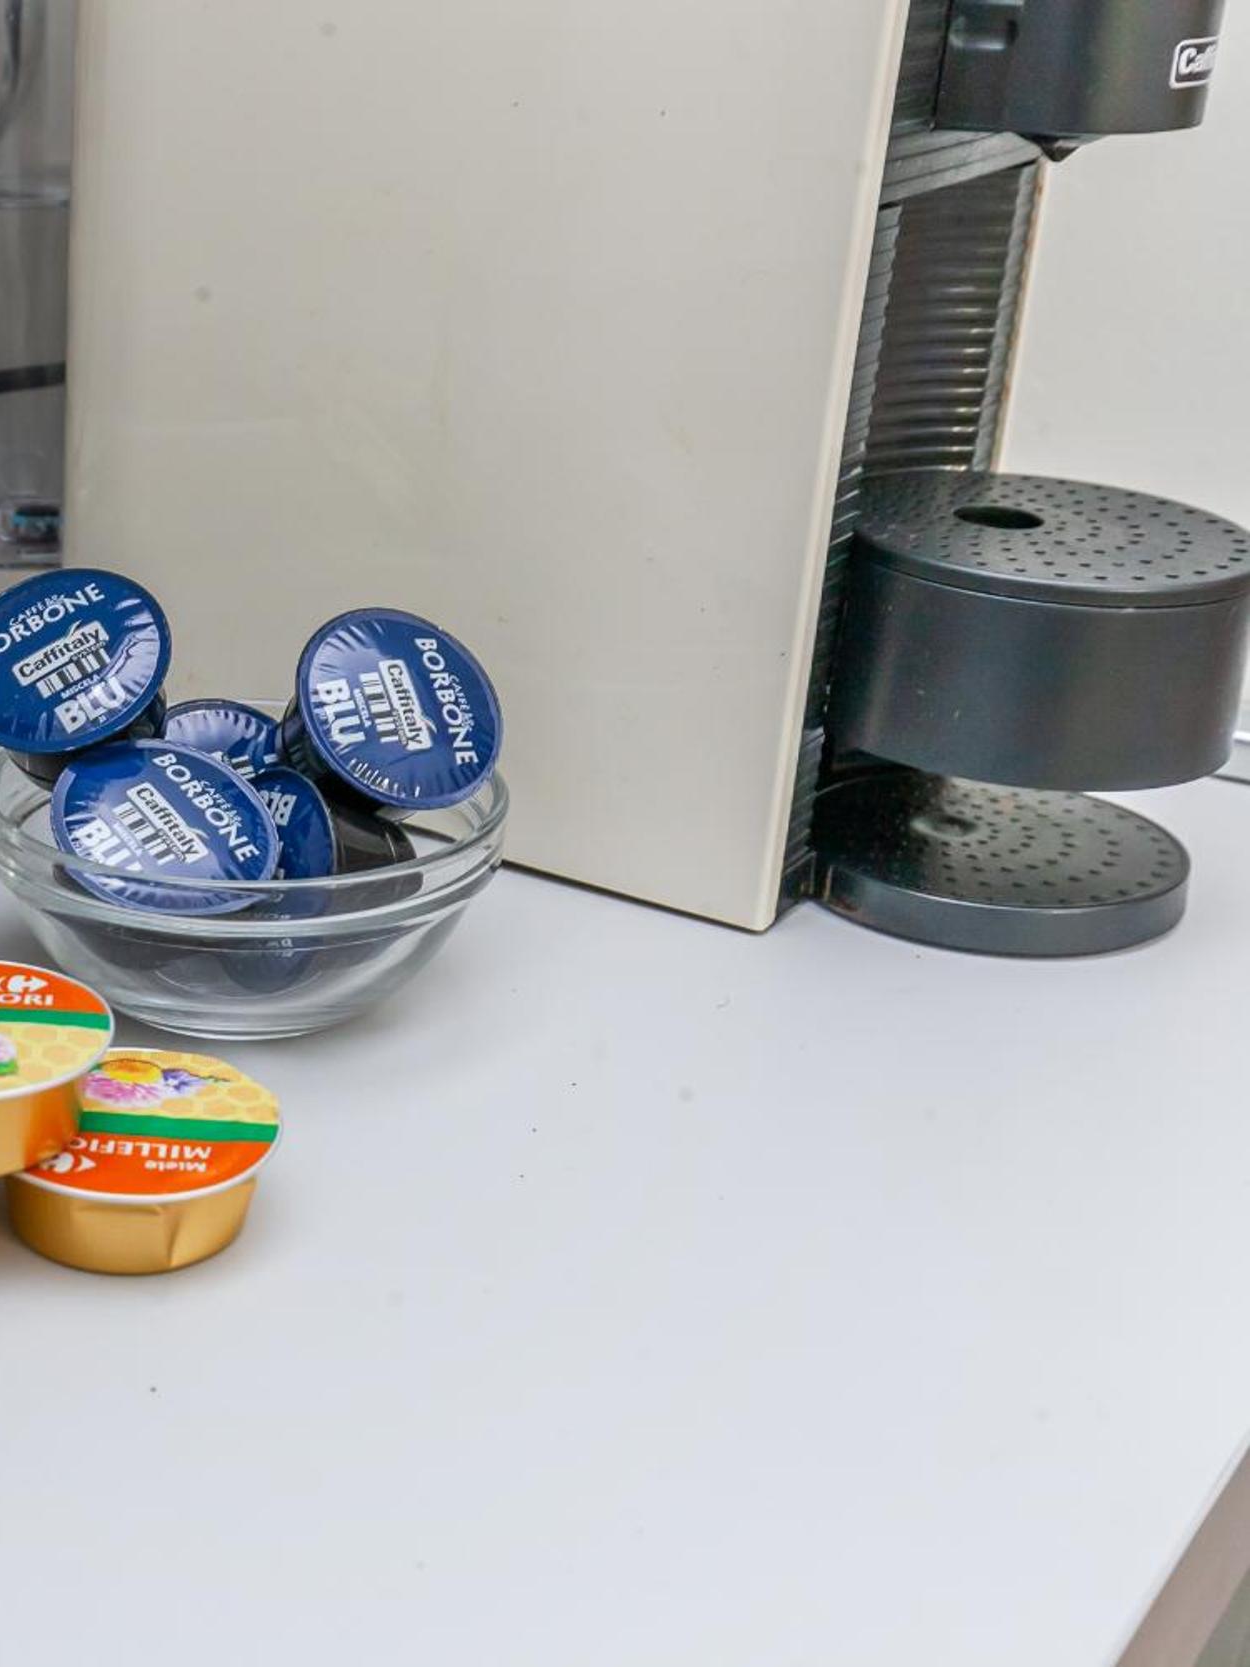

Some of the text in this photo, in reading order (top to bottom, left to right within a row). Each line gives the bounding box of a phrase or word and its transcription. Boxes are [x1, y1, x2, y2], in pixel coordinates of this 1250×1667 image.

[18, 627, 100, 678] Caffitaly
[54, 676, 126, 734] BLU
[316, 678, 366, 747] BLU
[388, 664, 423, 745] Caffitaly
[414, 638, 479, 765] BORBONE
[136, 787, 200, 858] Caffitaly
[152, 753, 260, 862] BORBONE
[144, 1160, 207, 1172] Miele
